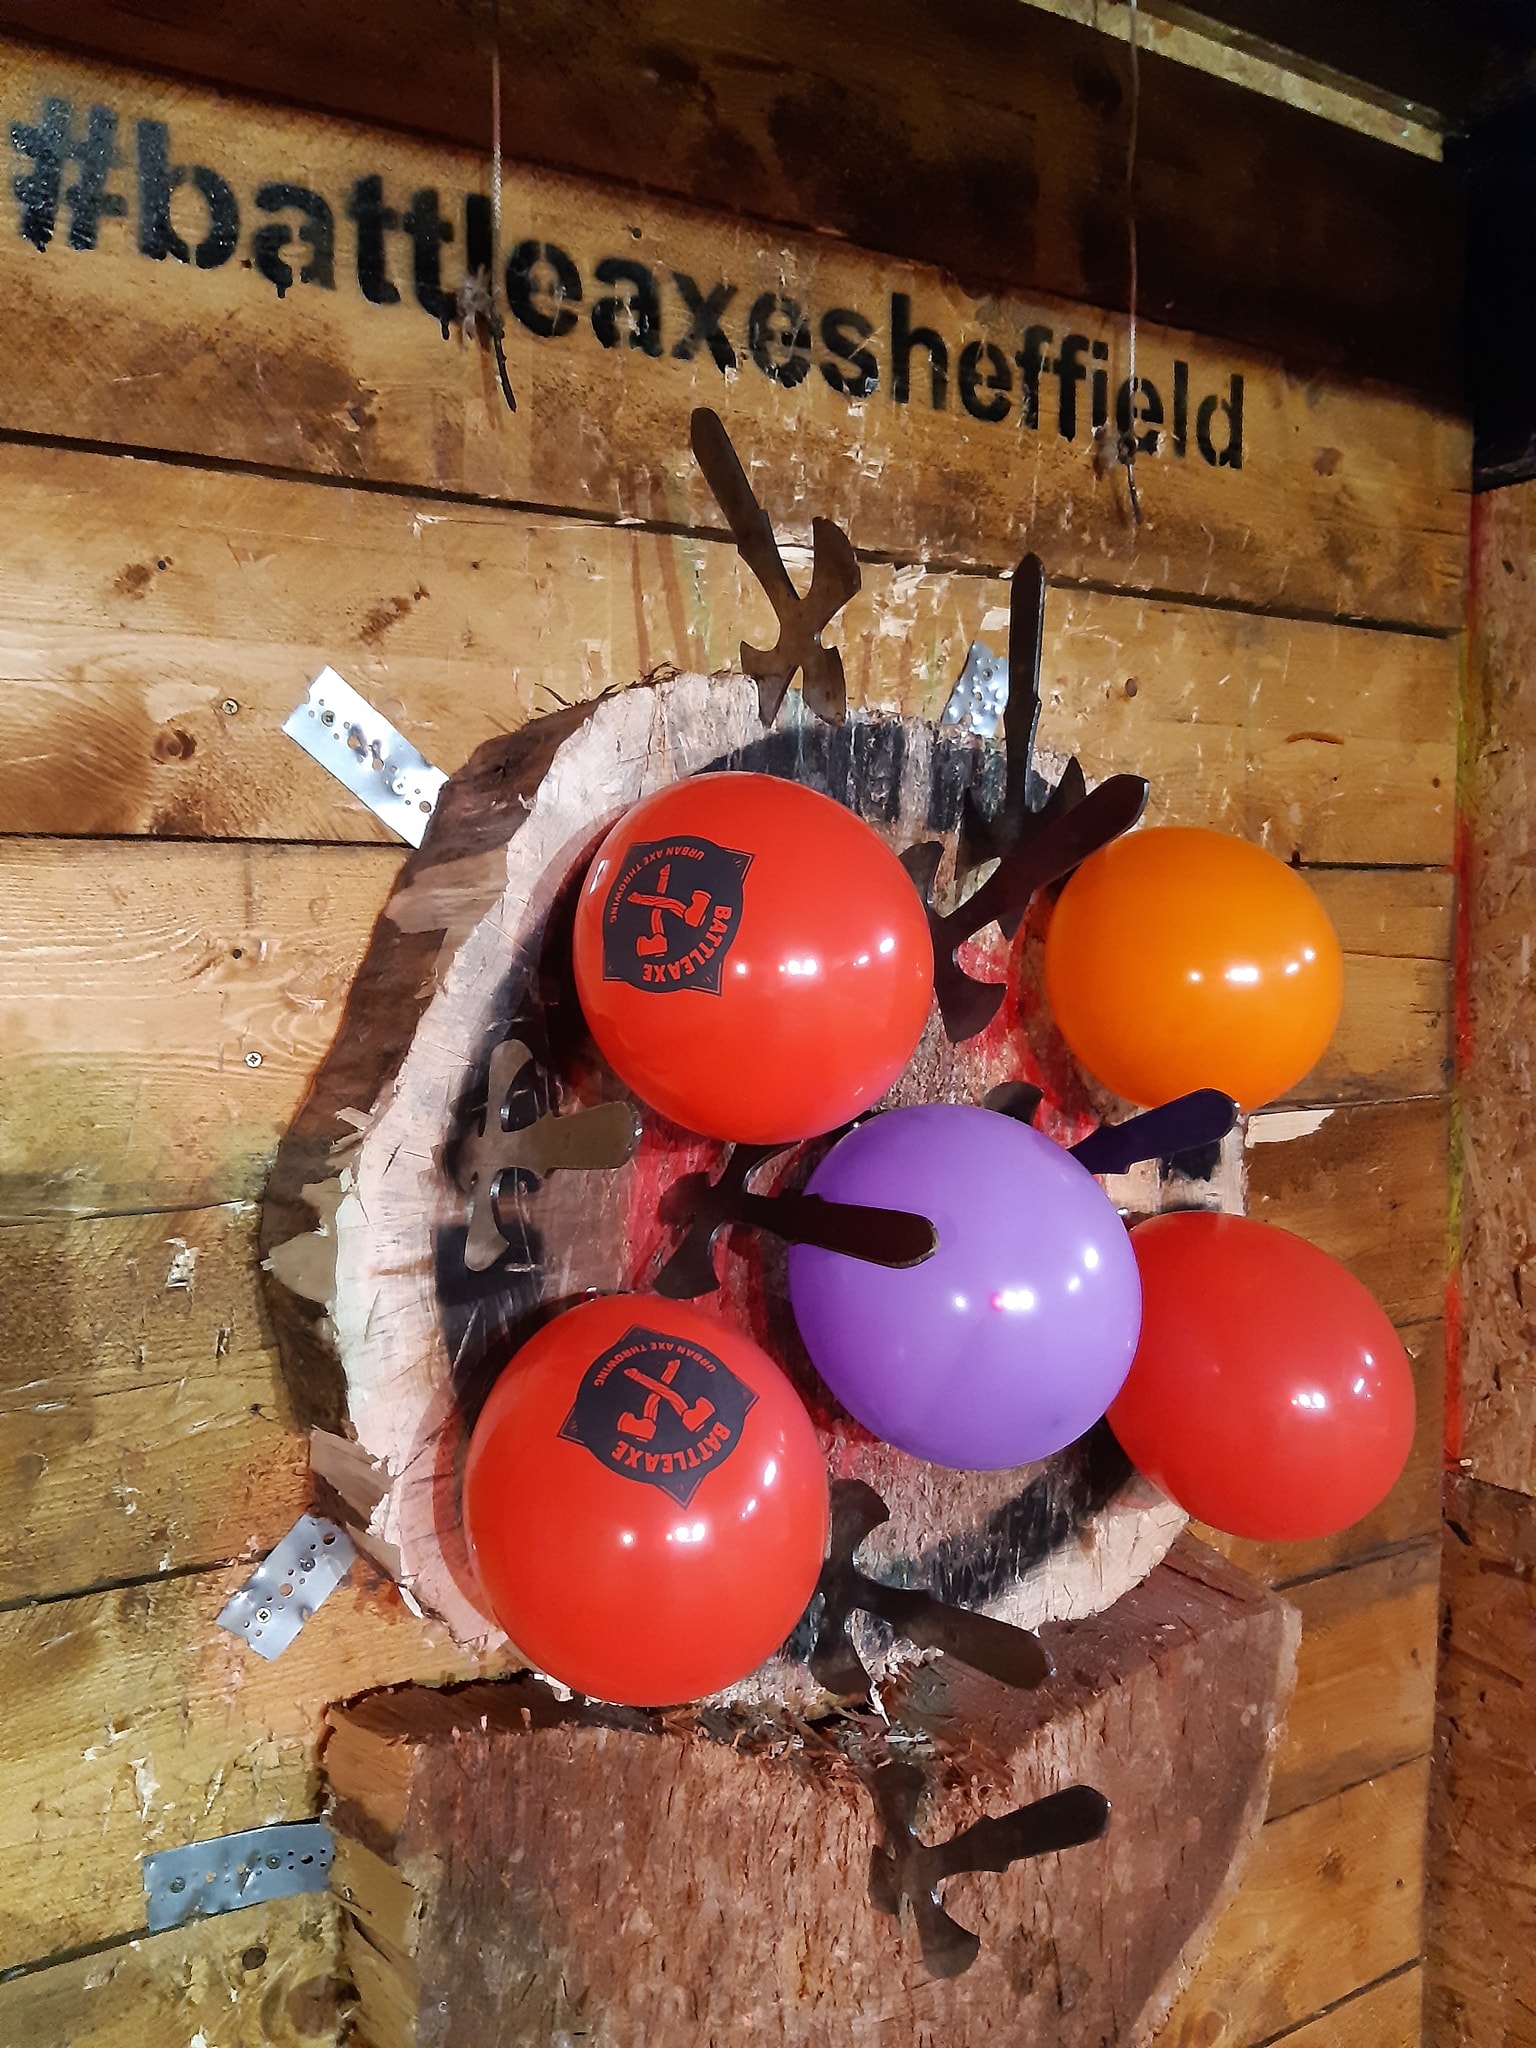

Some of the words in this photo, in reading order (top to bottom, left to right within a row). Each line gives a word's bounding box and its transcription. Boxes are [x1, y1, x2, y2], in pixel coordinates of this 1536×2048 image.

[10, 96, 1244, 470] #battleaxesheffield
[643, 849, 663, 866] AXE
[666, 846, 705, 861] URBAN
[609, 863, 643, 923] THROWING
[642, 905, 732, 983] BATTLEAXE
[593, 1342, 647, 1387] THROWING
[651, 1341, 674, 1351] AXE
[677, 1344, 717, 1373] URBAN
[611, 1421, 731, 1473] BATTLEAXE
